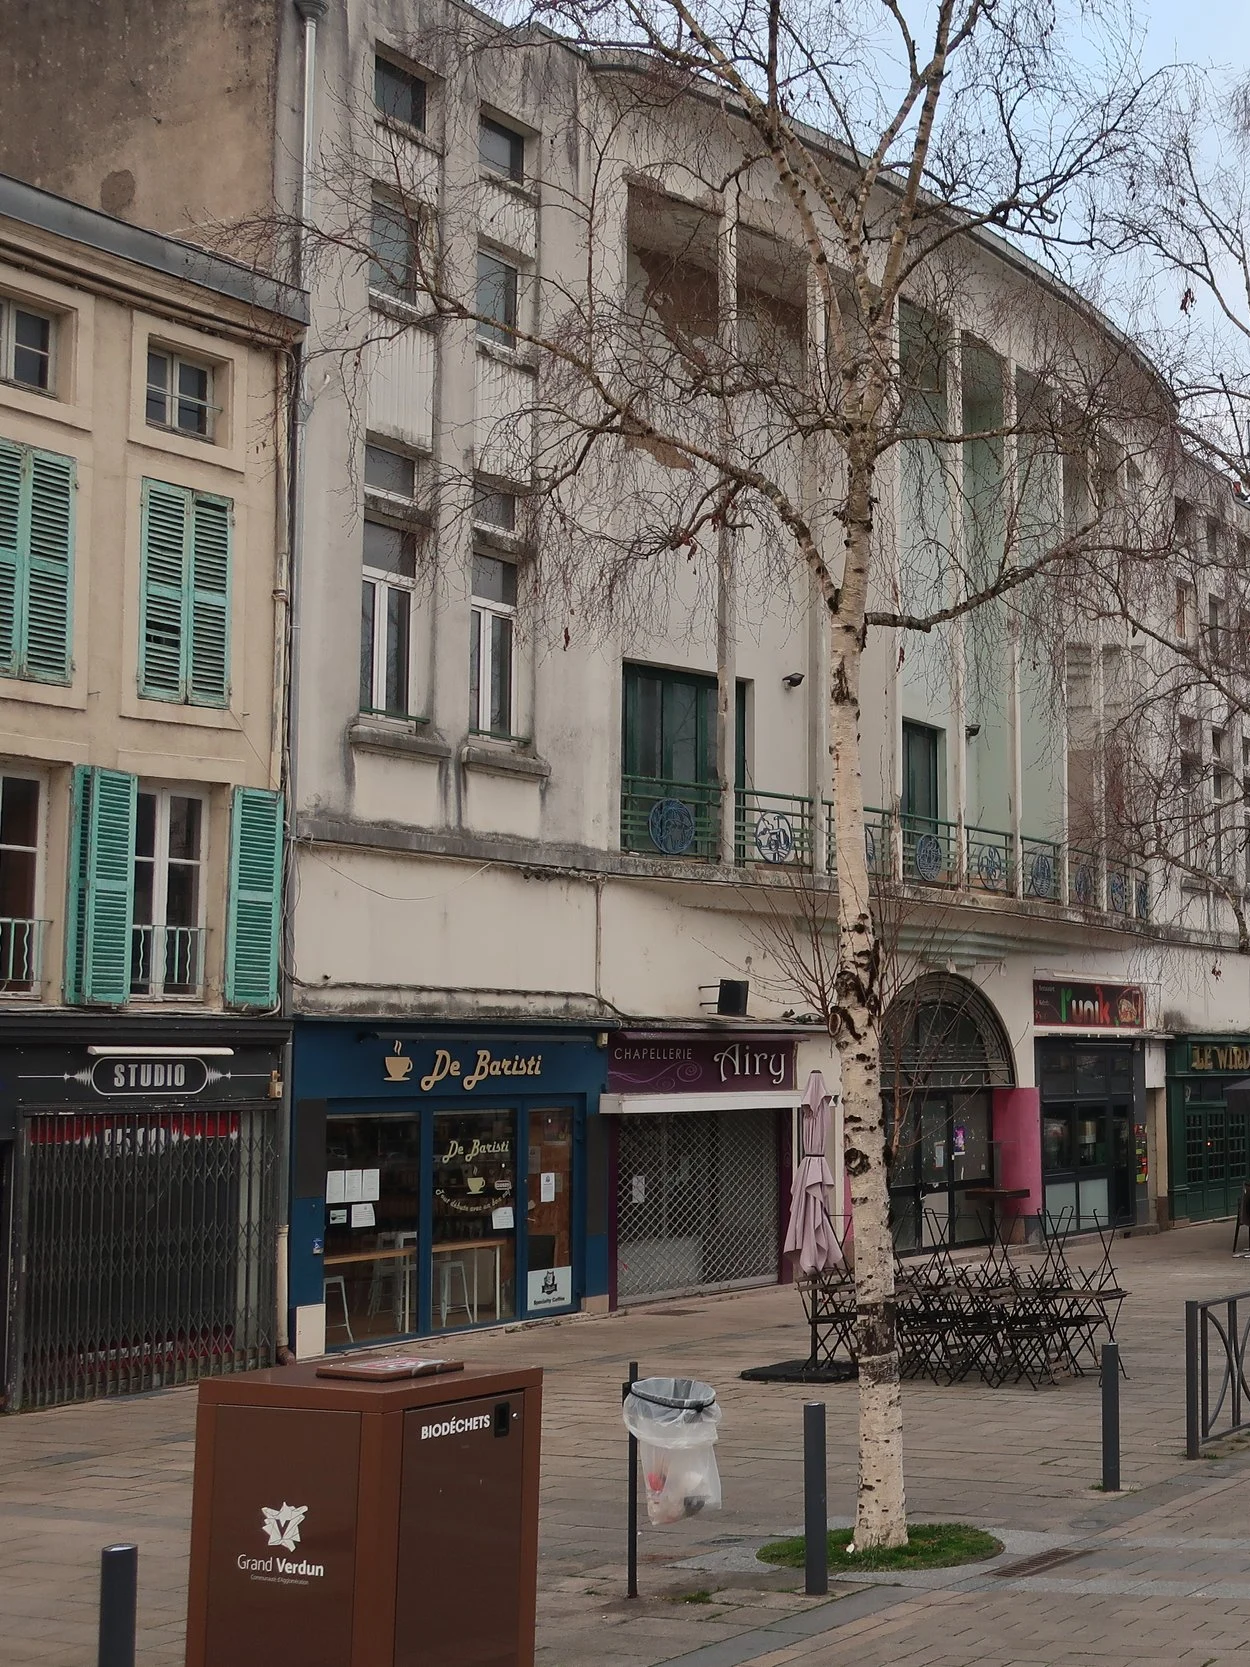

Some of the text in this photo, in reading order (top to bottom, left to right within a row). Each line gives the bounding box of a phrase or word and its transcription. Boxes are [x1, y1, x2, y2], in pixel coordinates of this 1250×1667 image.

[614, 1047, 693, 1060] CHAPELLERIE
[713, 1043, 786, 1084] Airy
[1191, 1046, 1213, 1070] LE
[114, 1063, 186, 1087] STUDIO
[420, 1049, 542, 1091] De Baristi
[442, 1139, 510, 1163] De Baristi
[421, 1414, 491, 1440] BIODÉCHETS
[237, 1554, 324, 1577] Grand Verdun
